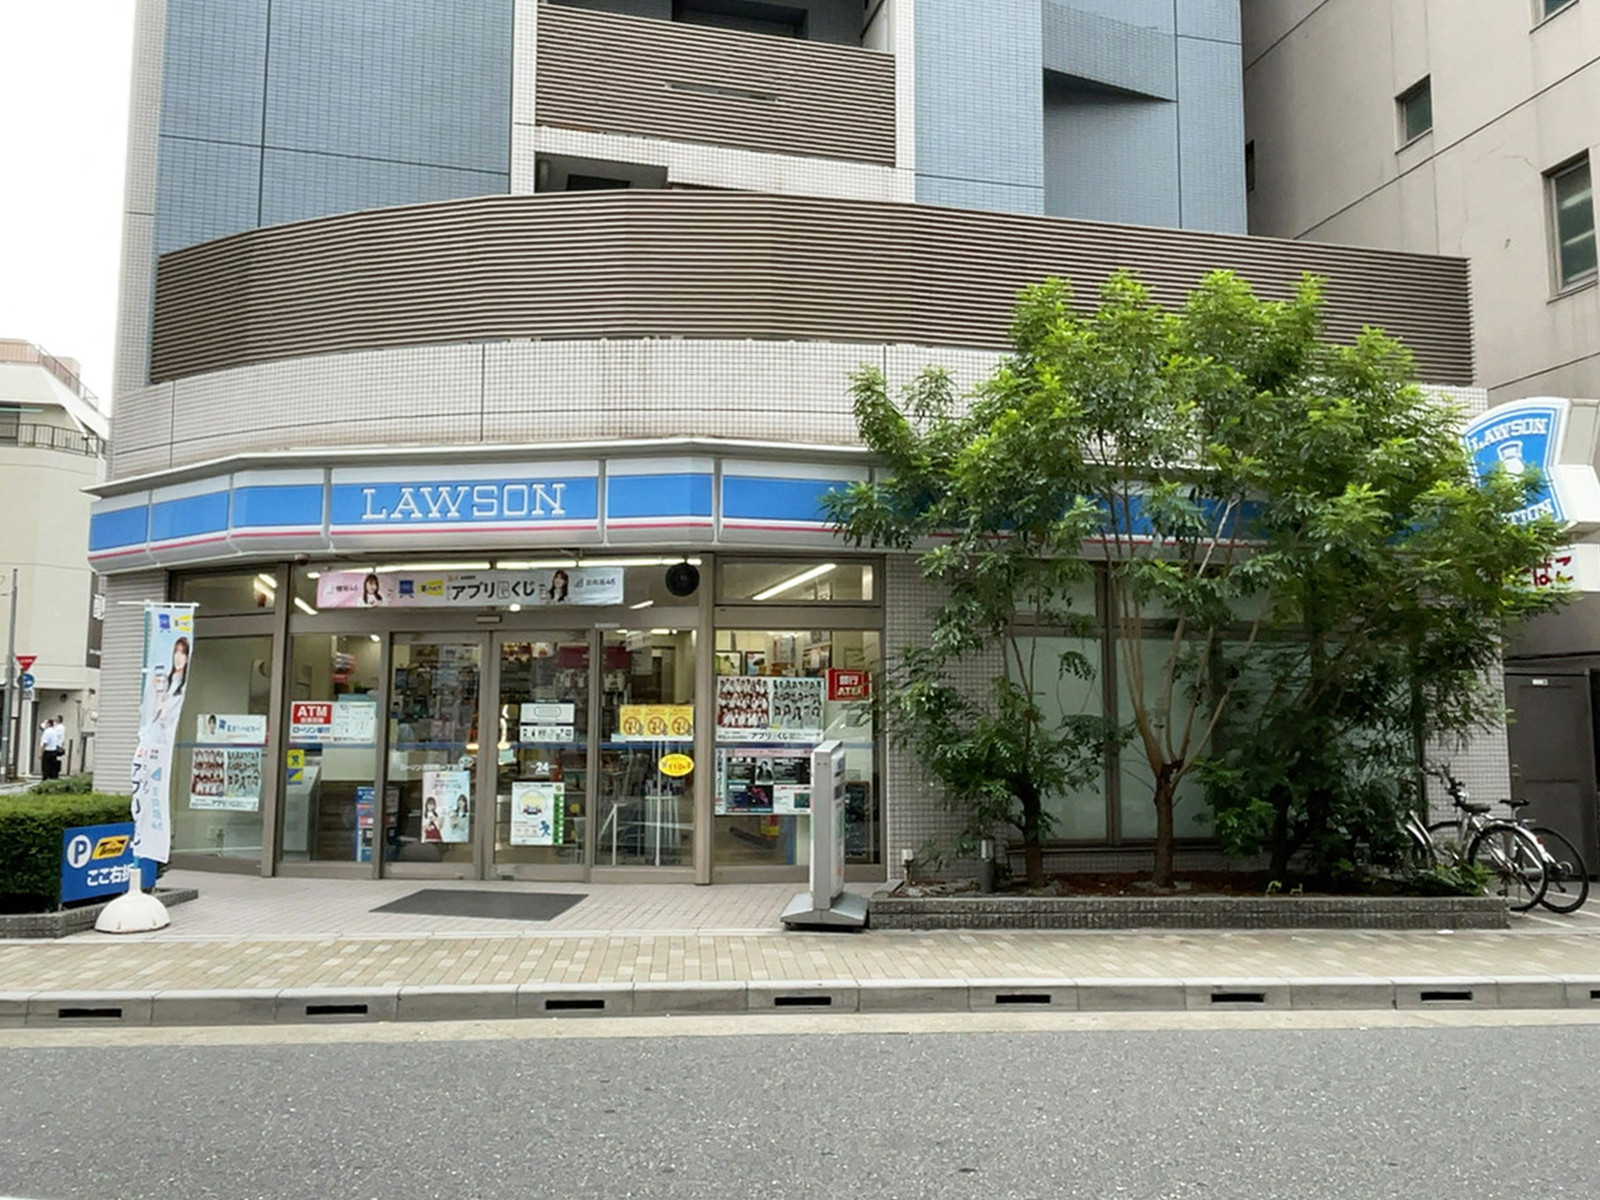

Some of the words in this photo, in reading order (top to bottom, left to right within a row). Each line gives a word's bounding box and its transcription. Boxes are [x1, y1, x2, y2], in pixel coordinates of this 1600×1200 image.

[1469, 418, 1548, 451] LAWSON
[361, 483, 566, 520] LAWSON
[297, 705, 328, 718] ATM
